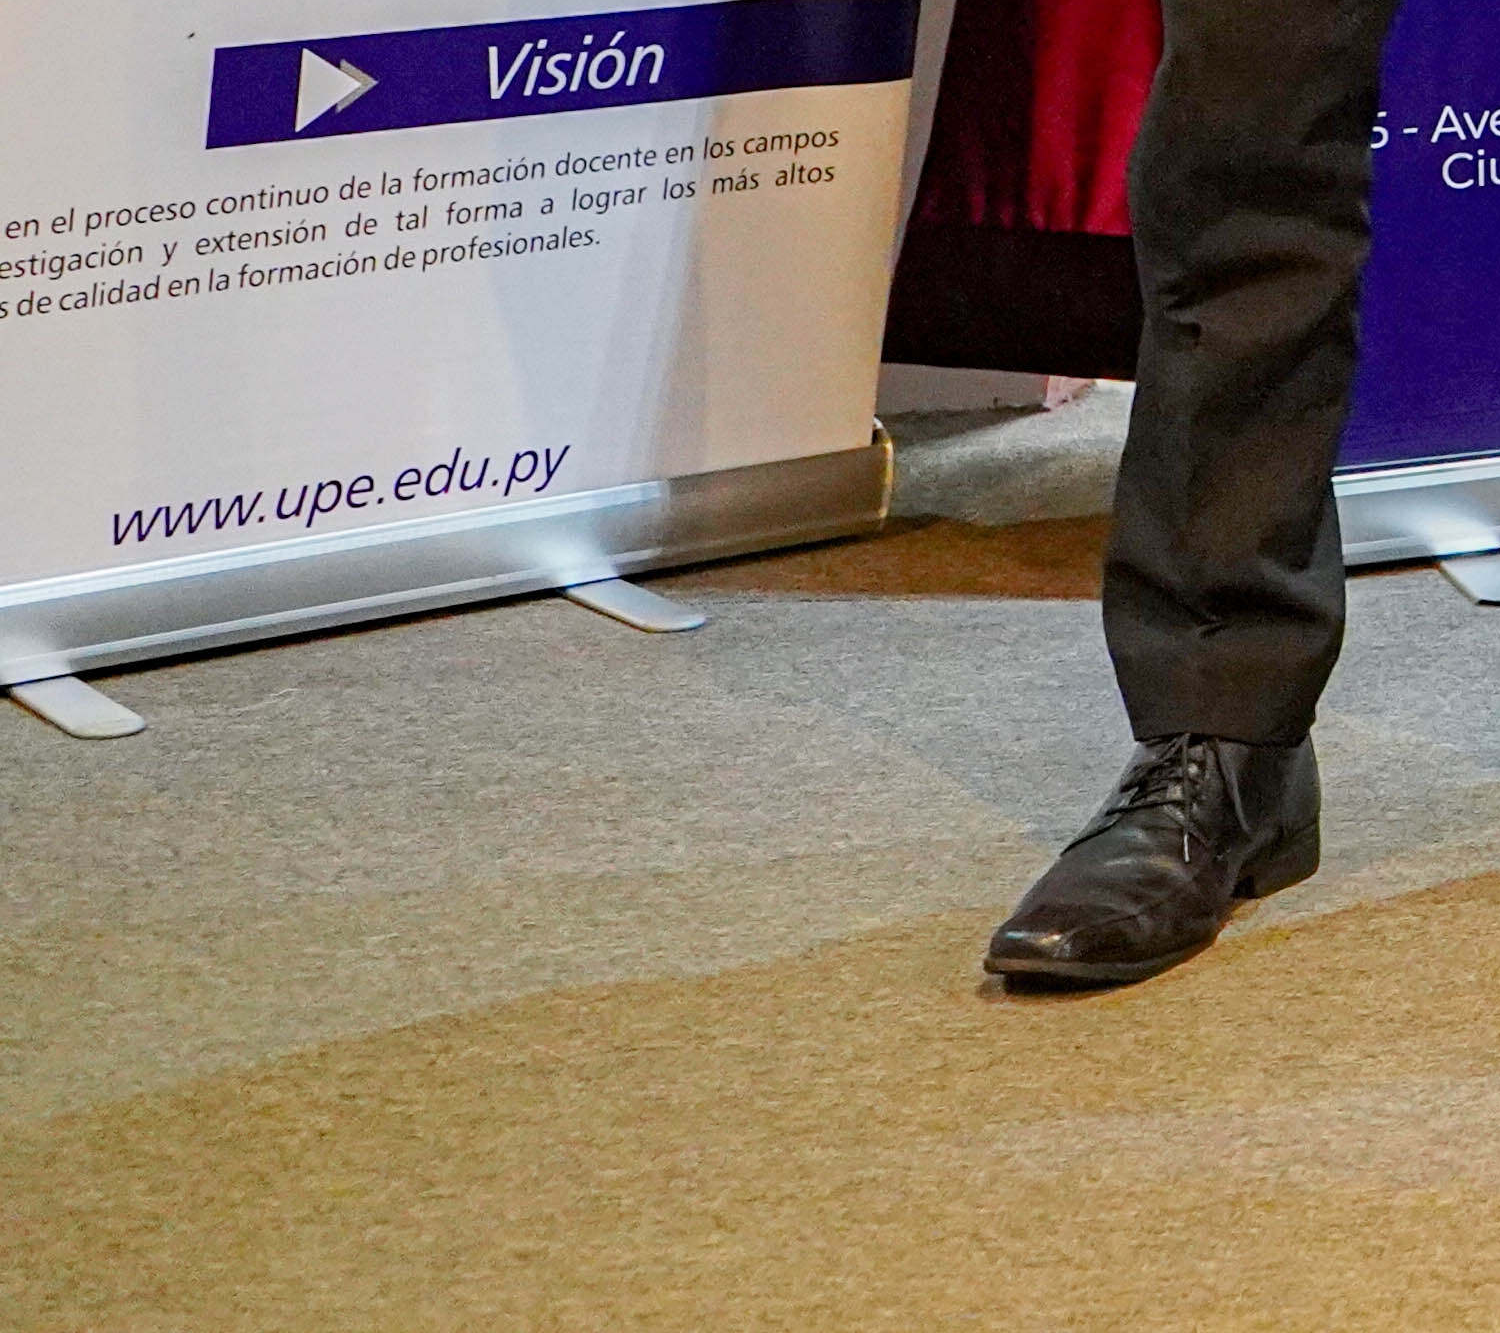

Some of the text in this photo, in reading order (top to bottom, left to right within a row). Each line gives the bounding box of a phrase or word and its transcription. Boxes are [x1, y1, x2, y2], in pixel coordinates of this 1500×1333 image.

[486, 31, 665, 102] Visión
[6, 127, 839, 239] en el proceso continuo de la formación docente en los campos
[162, 241, 178, 266] y
[195, 220, 327, 255] extensión
[345, 212, 378, 237] de
[396, 205, 428, 232] tal
[445, 198, 523, 227] forma
[540, 197, 555, 215] a
[571, 186, 648, 216] lograr
[663, 177, 697, 200] los
[712, 167, 760, 195] más
[775, 163, 835, 187] altos
[16, 290, 52, 317] de
[59, 275, 161, 312] calidad
[168, 277, 200, 298] en
[209, 268, 230, 293] la
[238, 251, 377, 289] formación
[384, 245, 416, 271] de
[421, 226, 601, 272] profesionales.
[109, 438, 573, 548] www.upe.edu.py
